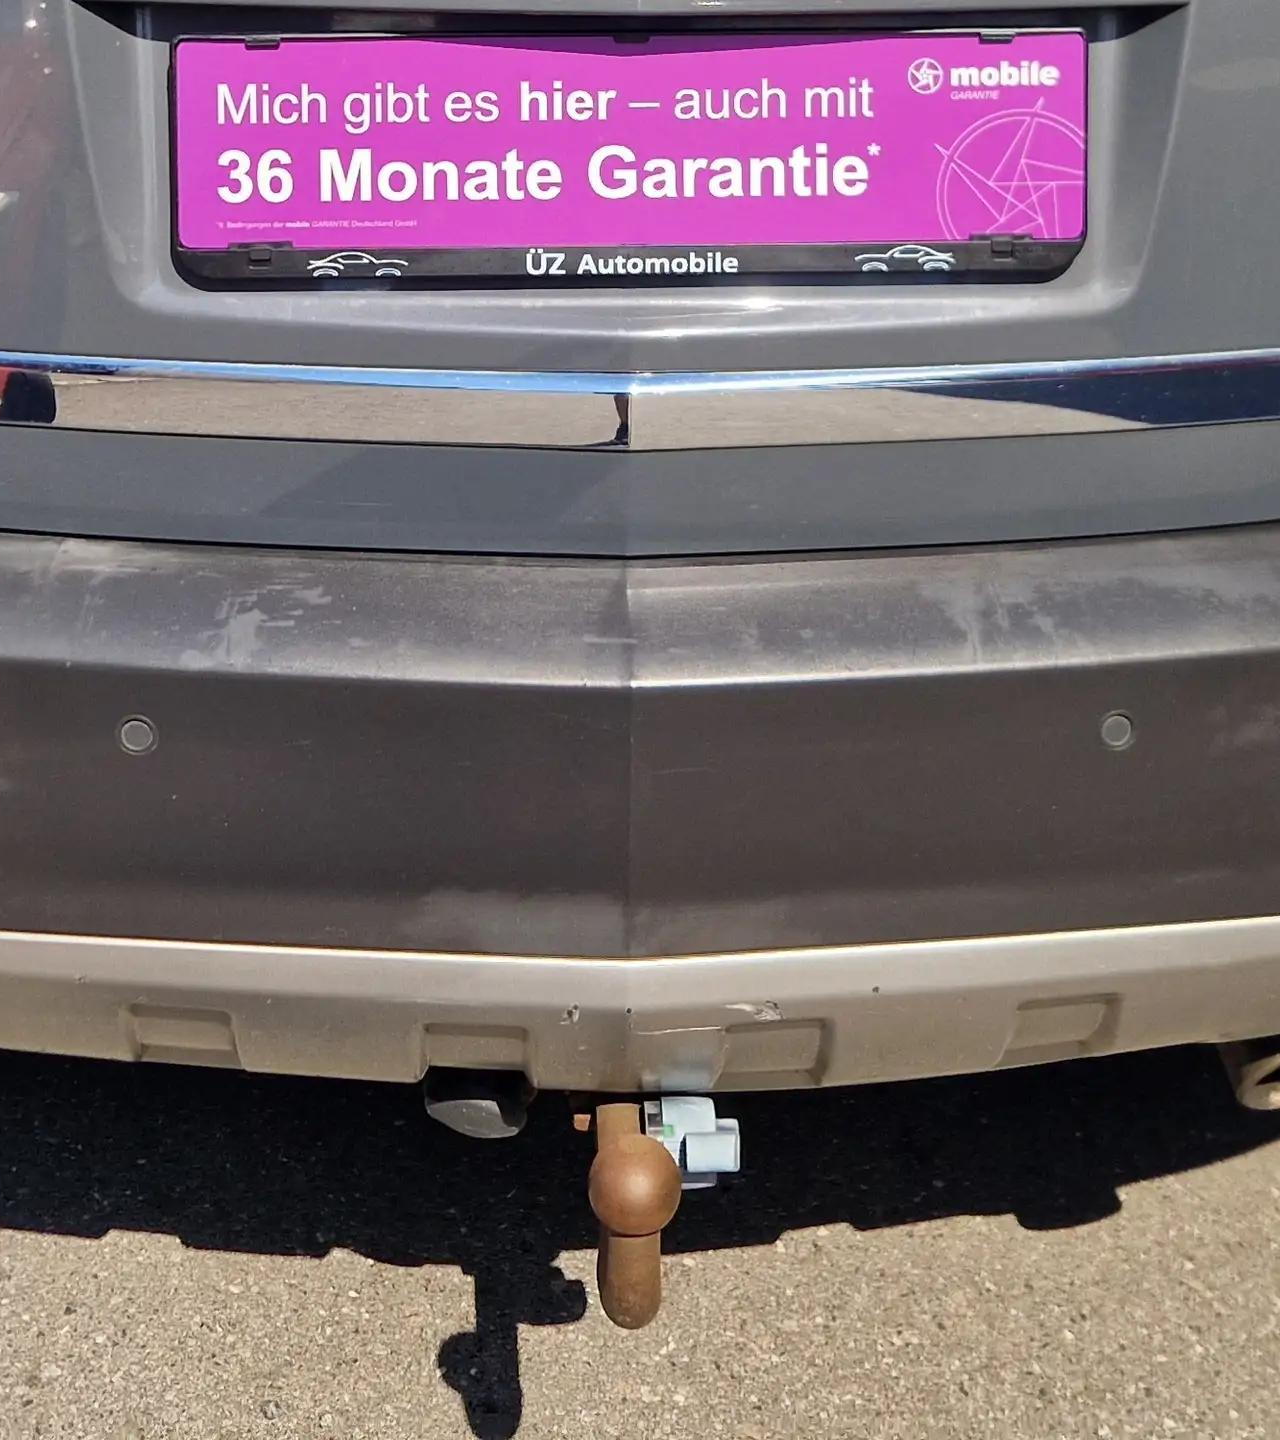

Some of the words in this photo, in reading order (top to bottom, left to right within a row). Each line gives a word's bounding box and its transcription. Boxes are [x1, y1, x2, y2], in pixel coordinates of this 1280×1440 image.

[949, 60, 1061, 87] mobile
[216, 83, 327, 124] Mich
[343, 83, 430, 134] gibt
[443, 89, 500, 123] es
[519, 81, 617, 122] hier
[674, 78, 787, 120] auch
[804, 78, 875, 119] mit
[950, 89, 1000, 100] GARANTIE
[216, 149, 294, 204] 36
[319, 148, 563, 203] Monate
[525, 247, 567, 276] ÜZ
[576, 251, 740, 276] Automobile
